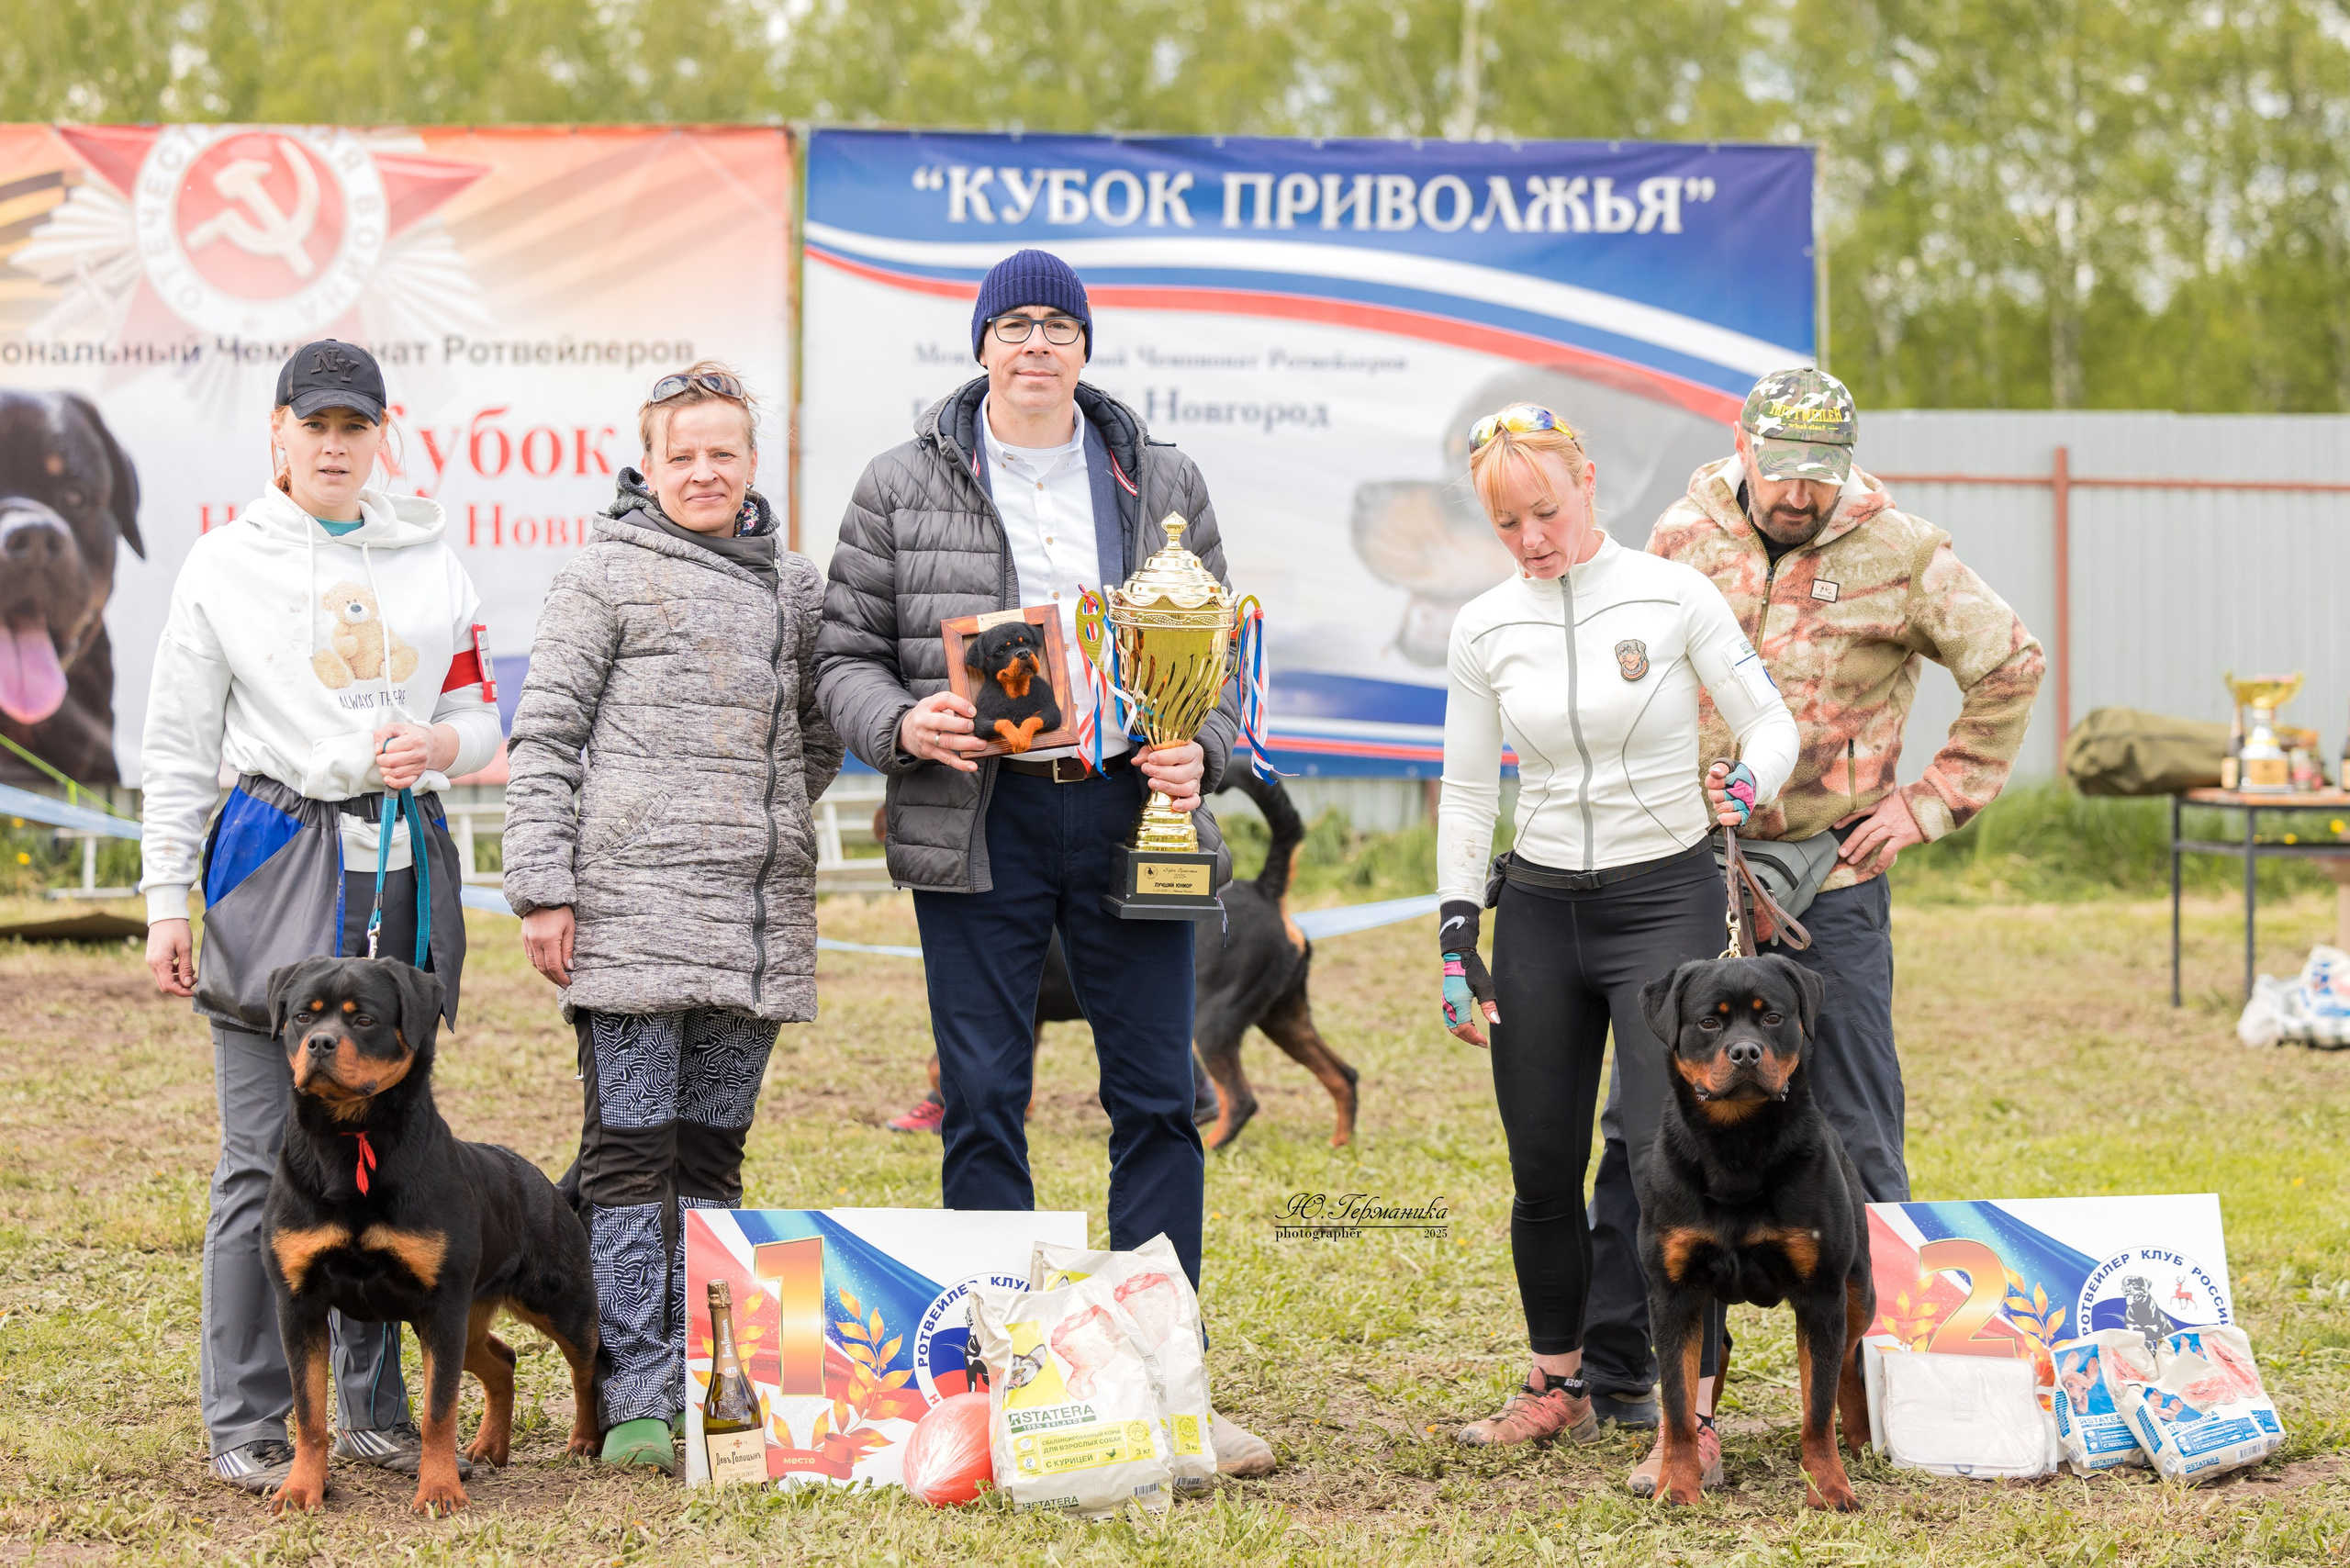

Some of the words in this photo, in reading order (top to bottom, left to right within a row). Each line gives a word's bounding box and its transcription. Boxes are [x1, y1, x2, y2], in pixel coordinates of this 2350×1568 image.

[443, 334, 697, 372] Ротвейлеров
[310, 348, 360, 383] NY
[1144, 387, 1333, 433] Новгород
[1769, 401, 1843, 423] ROTTWEILER
[339, 693, 375, 710] ALWAYS
[2141, 1249, 2184, 1266] КЛУБ
[1919, 1238, 2018, 1358] 2
[754, 1236, 824, 1396] 1
[1022, 1404, 1096, 1424] STATERA
[1023, 1423, 1044, 1431] 100%
[1046, 1417, 1084, 1429] BALANCE
[1042, 1430, 1103, 1447] СБАЛАНСИРОВАННЫЙ
[1103, 1429, 1121, 1438] КОРМ
[1043, 1446, 1058, 1455] ДЛЯ
[1059, 1440, 1099, 1452] ВЗРОСЛЫХ
[1099, 1436, 1123, 1446] СОБАК
[2201, 1439, 2225, 1450] ЛОСОСЕМ
[716, 1452, 731, 1466] Левъ
[732, 1451, 761, 1465] Голицынъ
[1143, 1447, 1151, 1455] кг
[1046, 1460, 1052, 1468] С
[1053, 1454, 1094, 1467] КУРИЦЕЙ
[2095, 1457, 2124, 1466] STATERA
[2190, 1456, 2220, 1471] STATERA
